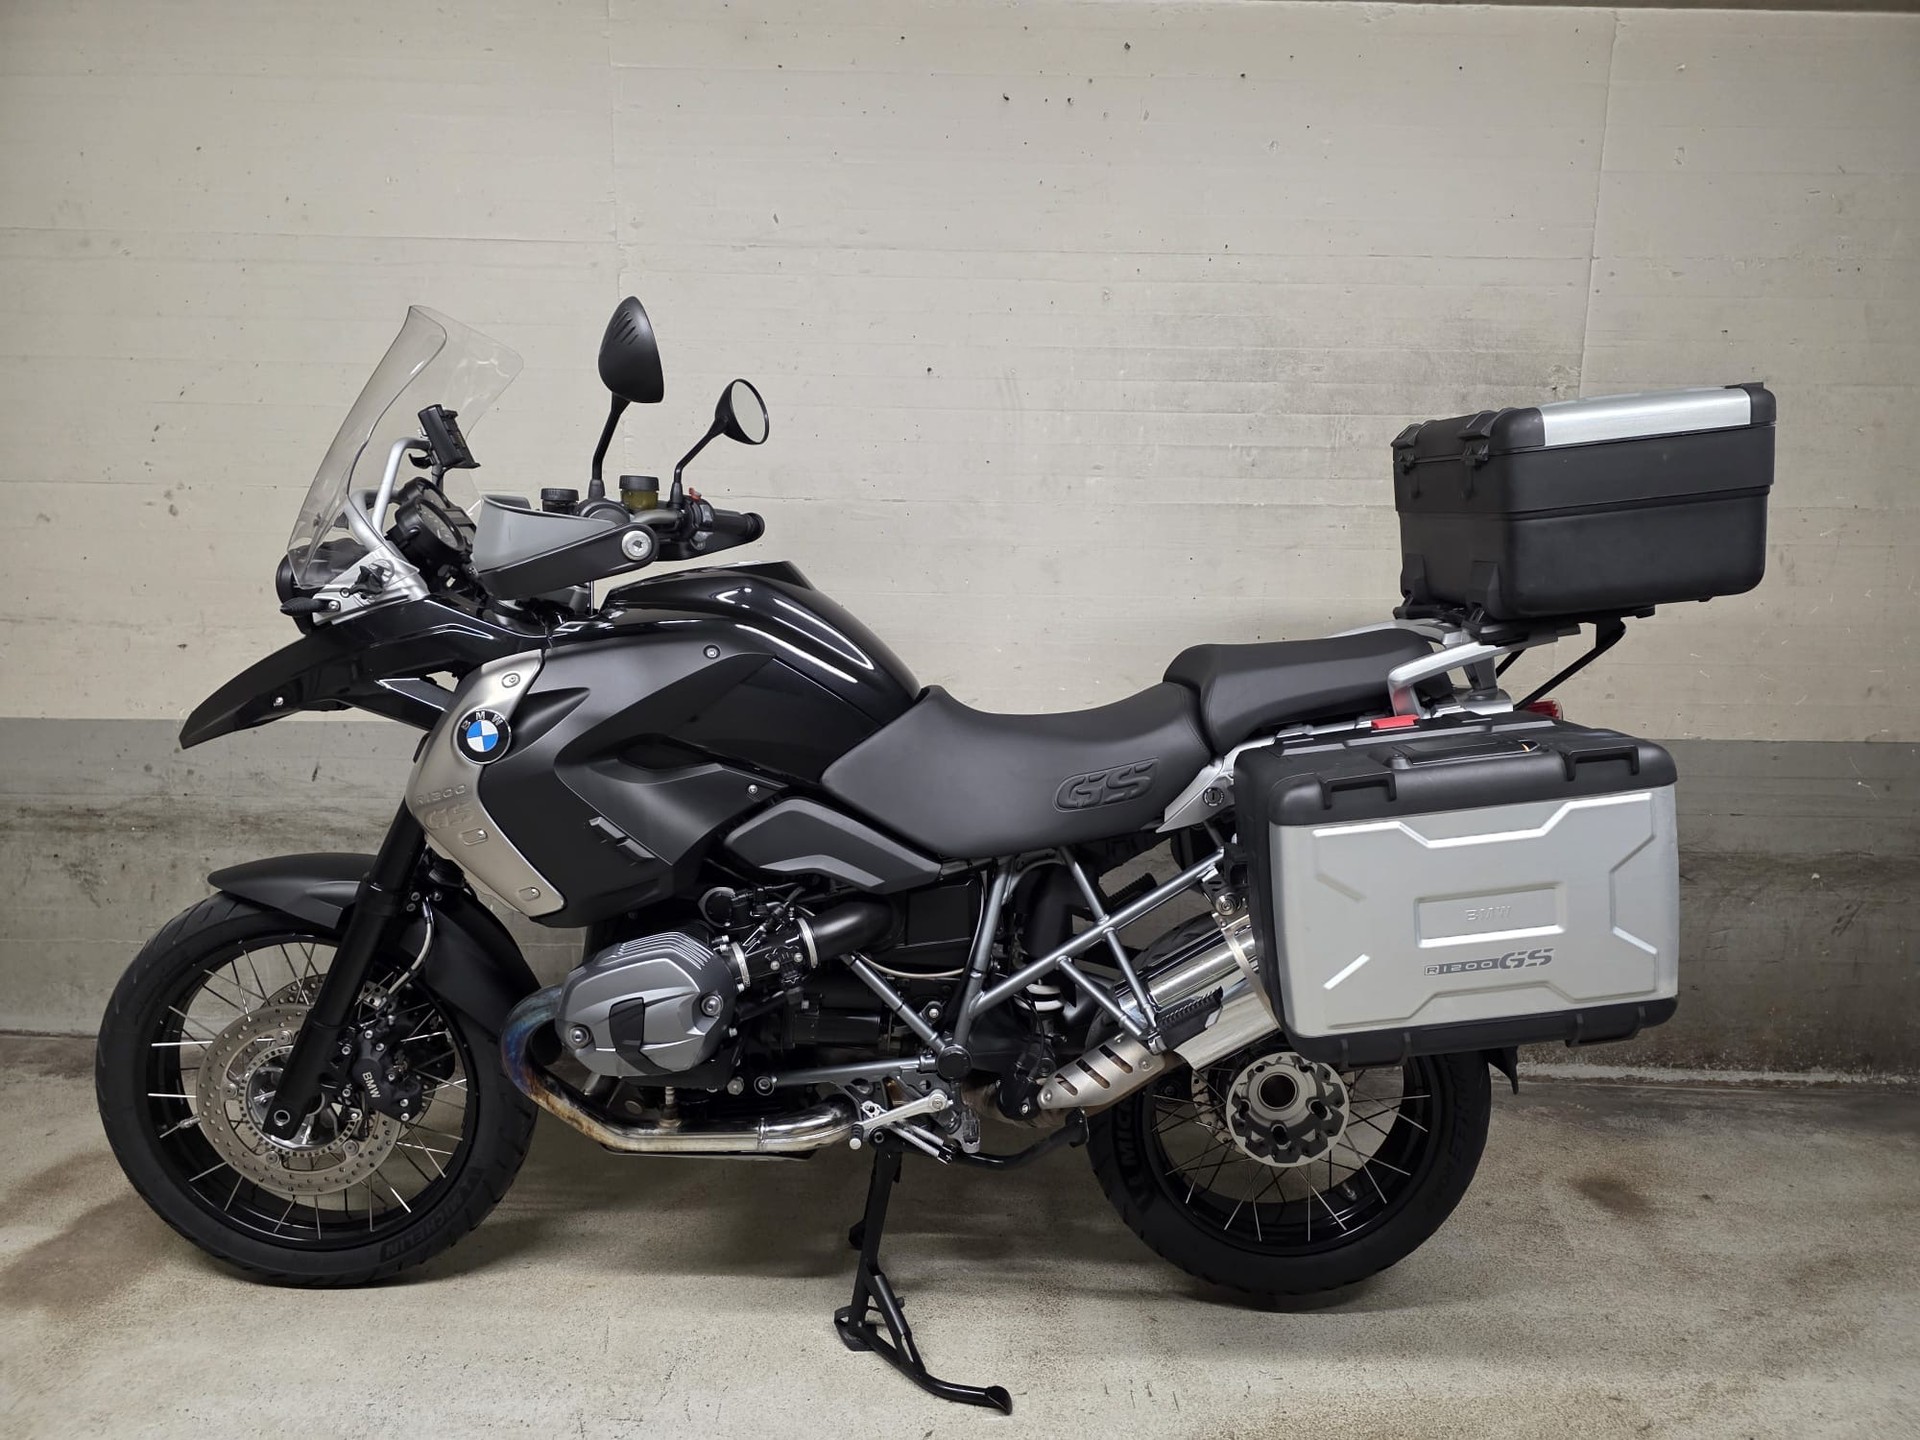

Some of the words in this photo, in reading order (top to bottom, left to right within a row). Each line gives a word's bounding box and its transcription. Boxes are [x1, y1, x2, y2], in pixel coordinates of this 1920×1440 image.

[461, 710, 503, 730] BMW
[1056, 759, 1157, 809] GS
[1465, 904, 1511, 920] BMW
[362, 1071, 381, 1098] BMW
